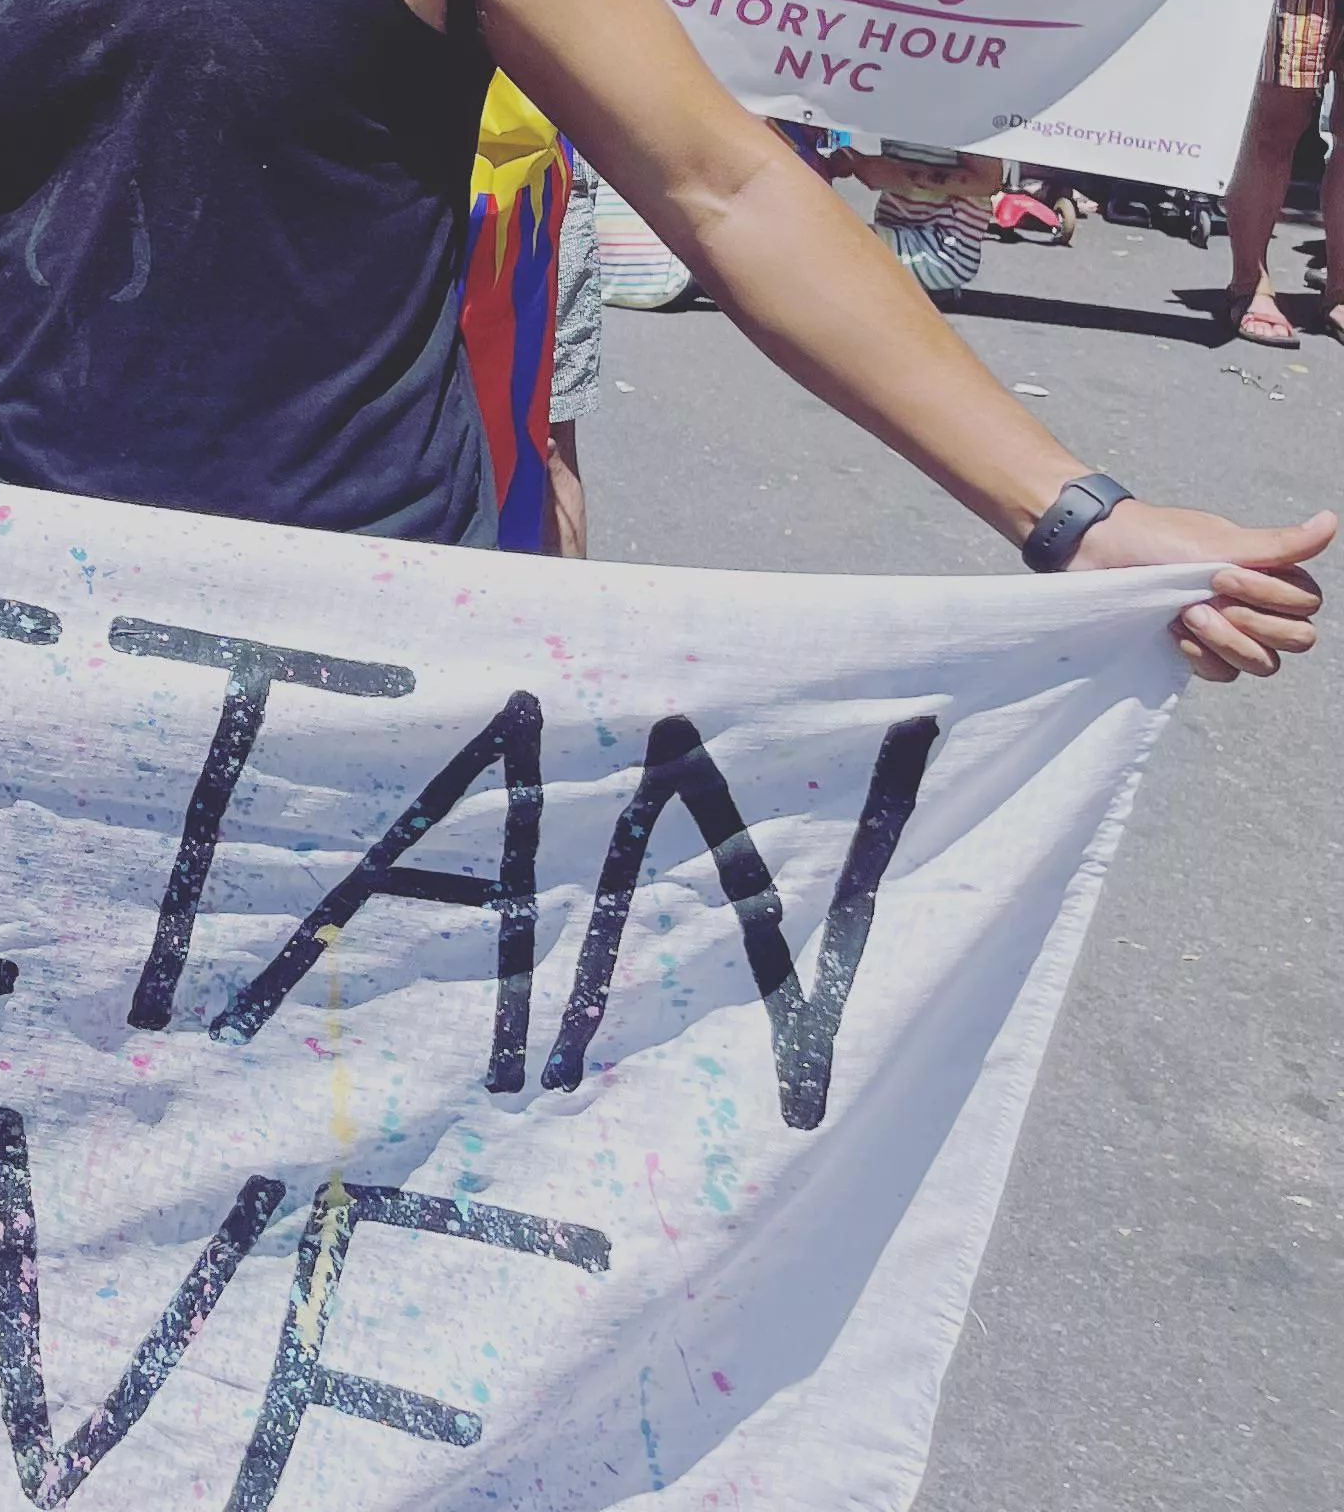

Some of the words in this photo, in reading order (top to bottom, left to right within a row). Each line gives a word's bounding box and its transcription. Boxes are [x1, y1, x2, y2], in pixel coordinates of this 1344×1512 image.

[773, 44, 886, 94] NYC
[858, 18, 1009, 71] HOUR
[991, 113, 1202, 159] @DragStoryHourNYC
